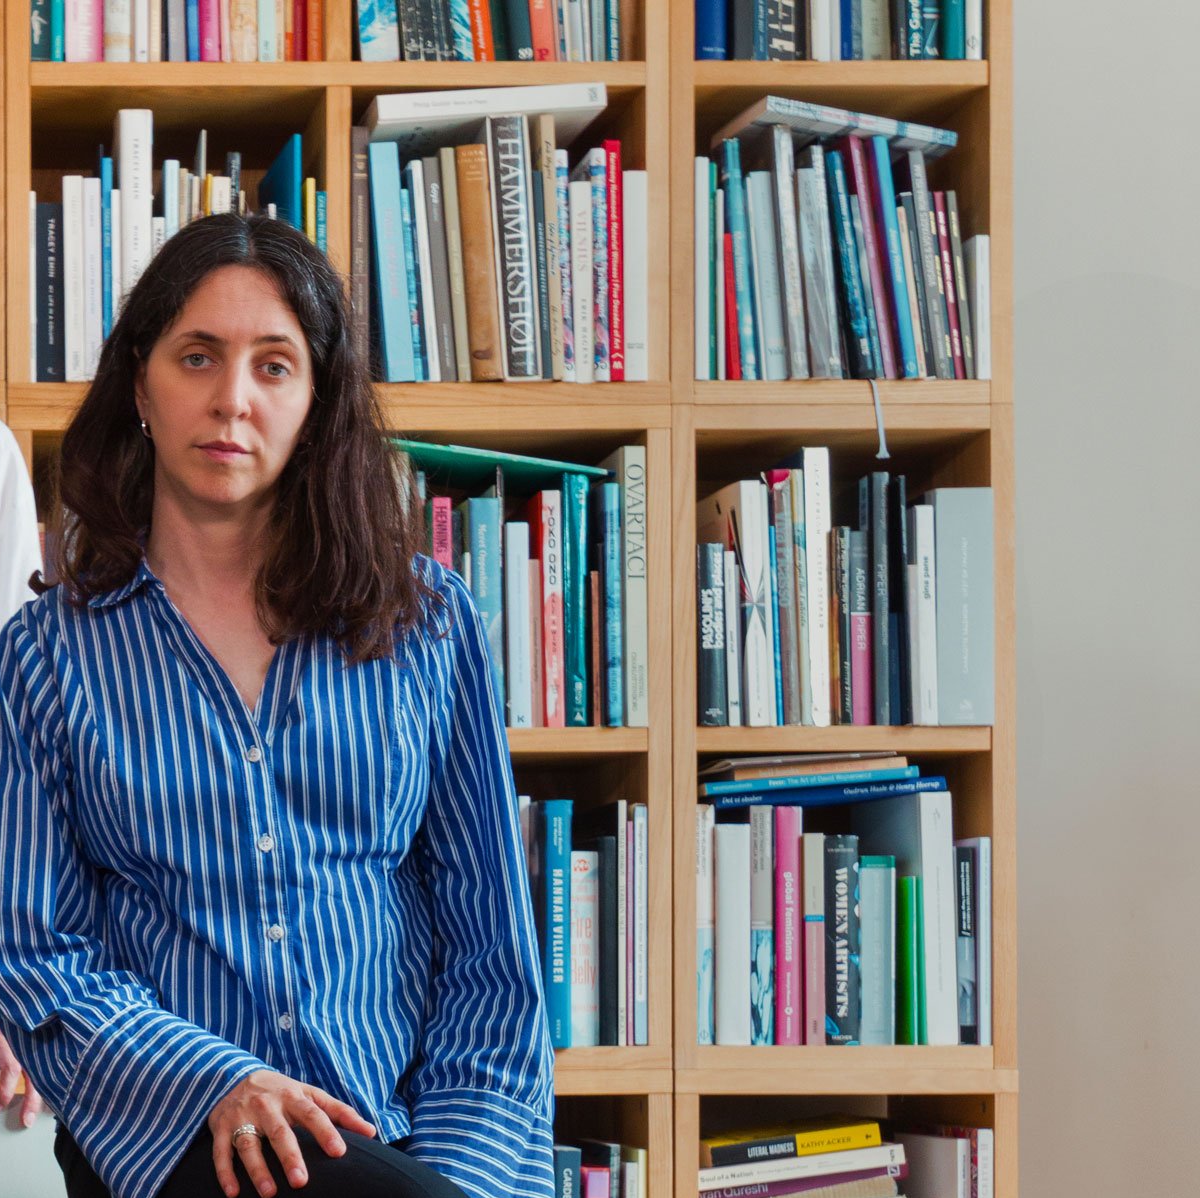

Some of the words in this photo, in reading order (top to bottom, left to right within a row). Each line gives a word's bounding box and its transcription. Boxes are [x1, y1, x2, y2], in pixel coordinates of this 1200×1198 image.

[908, 32, 921, 57] The
[608, 151, 620, 182] Harmony
[47, 218, 55, 253] TRACEY
[497, 137, 534, 356] HAMMERSHØI
[576, 209, 590, 273] VILNIUS
[611, 221, 620, 250] Material
[47, 256, 55, 278] EMIN
[612, 251, 620, 279] Witness
[580, 297, 588, 322] ERIK
[613, 299, 622, 328] Decades
[582, 326, 590, 365] HAGENS
[436, 505, 448, 553] HENNING
[478, 524, 488, 548] Meret
[547, 506, 557, 549] YOKO
[627, 463, 646, 580] OVARTACI
[477, 549, 488, 598] Oppenheim
[547, 552, 557, 585] ONO
[711, 551, 724, 587] places
[877, 563, 887, 597] PIPER
[922, 555, 931, 579] pane
[712, 587, 723, 610] and
[856, 567, 866, 611] ADRIAN
[922, 580, 931, 600] gina
[701, 588, 714, 650] PASOLINI'S
[712, 610, 724, 650] bodies
[856, 616, 866, 651] PIPER
[553, 868, 564, 922] HANNAH
[783, 871, 794, 904] global
[835, 867, 848, 935] WOMEN
[785, 907, 795, 962] feminisms
[553, 925, 564, 984] VILLIGER
[835, 936, 848, 1018] ARTISTS
[747, 1144, 768, 1159] LITERAL
[769, 1141, 795, 1156] MADNESS
[800, 1139, 825, 1149] KATHY
[826, 1136, 852, 1146] ACKER
